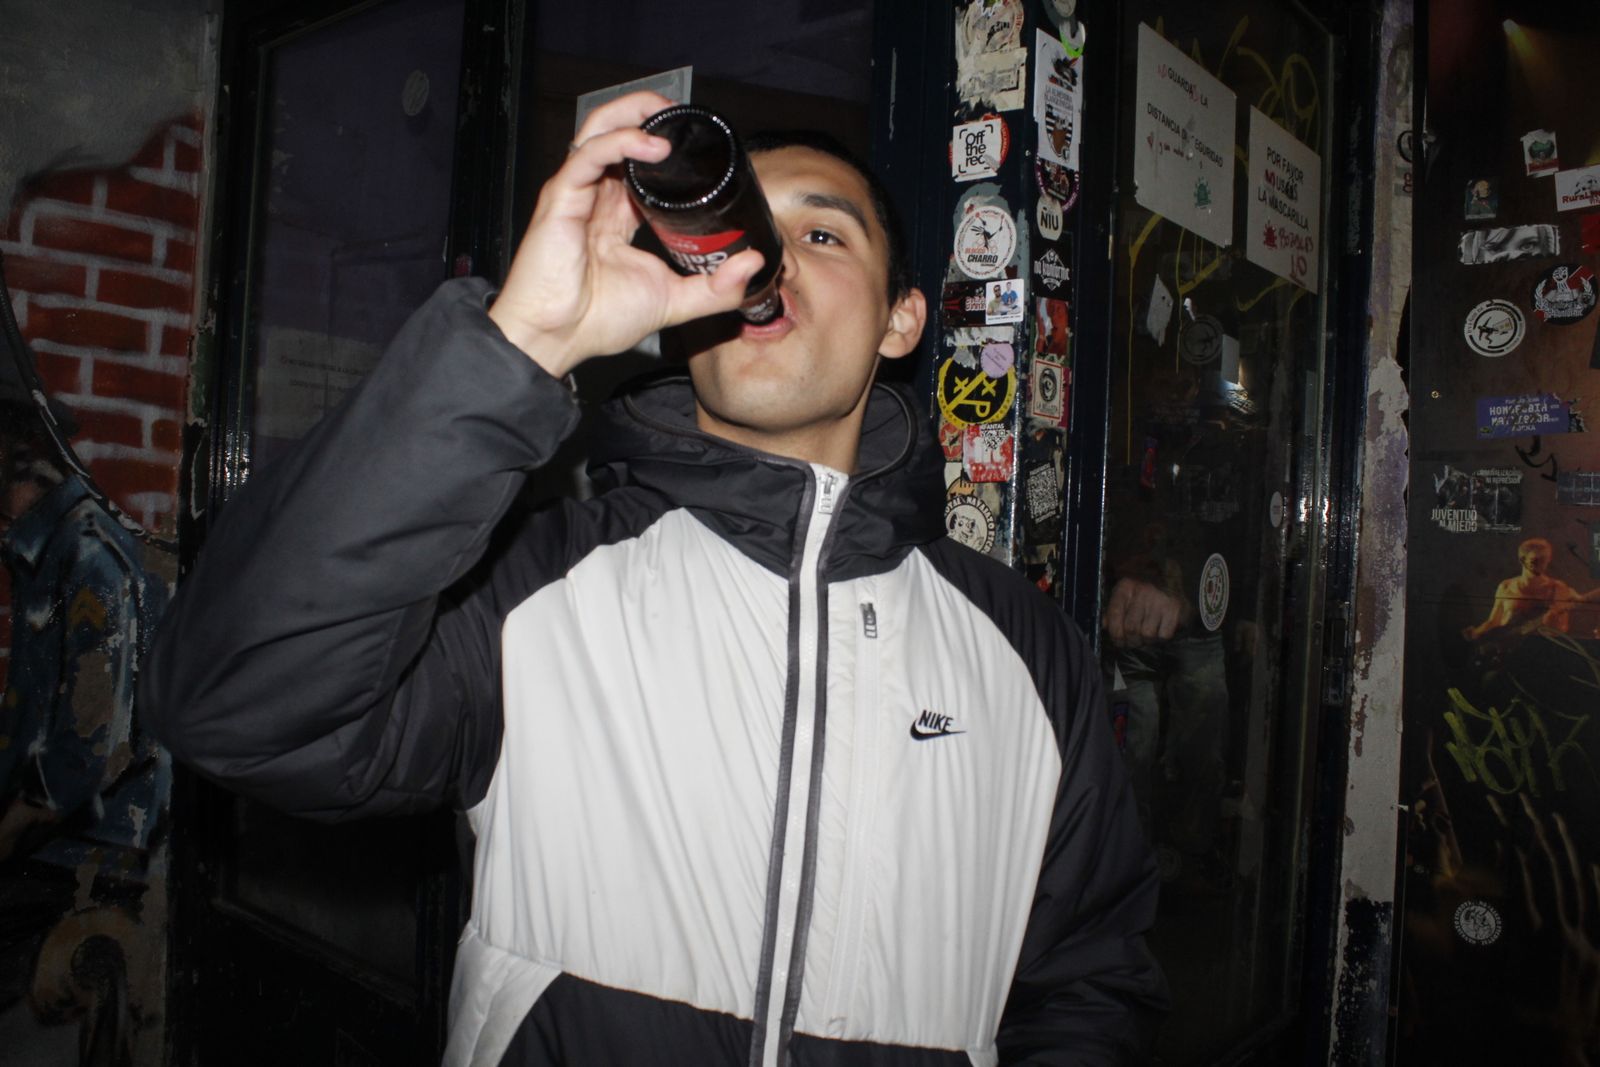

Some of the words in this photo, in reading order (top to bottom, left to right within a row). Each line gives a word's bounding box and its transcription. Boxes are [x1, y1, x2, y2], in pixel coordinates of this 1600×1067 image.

[1147, 102, 1180, 136] DISTANCIA
[965, 129, 986, 146] Off
[965, 142, 987, 157] the
[1266, 146, 1281, 169] POR
[1282, 158, 1304, 185] FAVOR
[1258, 186, 1267, 206] LA
[1268, 194, 1309, 231] MASCARILLA
[967, 254, 999, 264] CHARRO
[1431, 508, 1478, 521] JUVENTUD
[918, 709, 954, 732] NIKE
